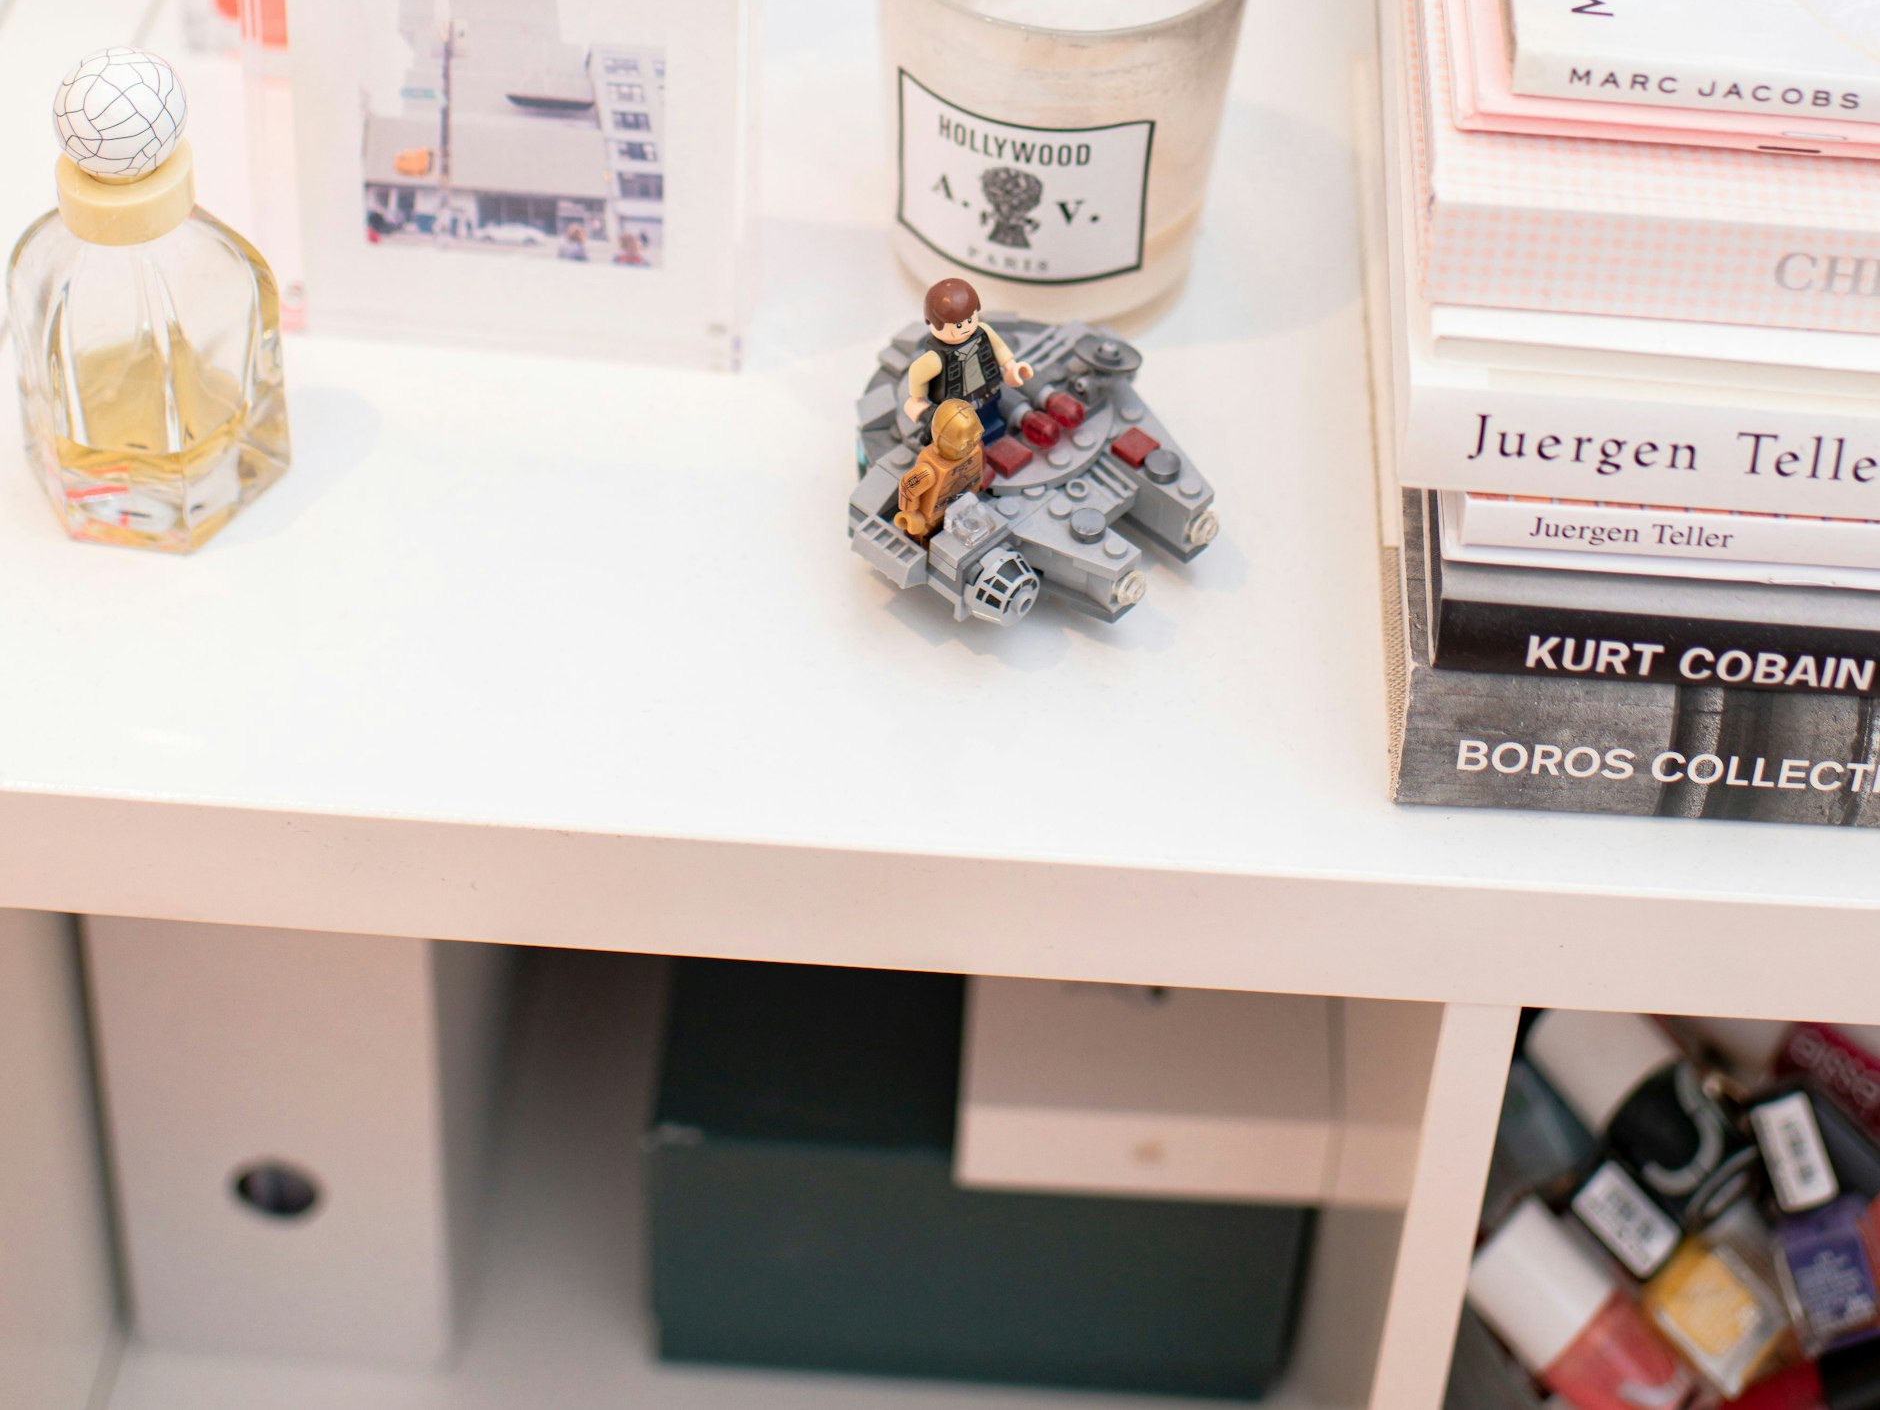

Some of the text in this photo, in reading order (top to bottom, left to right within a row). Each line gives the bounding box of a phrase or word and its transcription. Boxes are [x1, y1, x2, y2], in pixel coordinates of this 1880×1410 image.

[1568, 67, 1861, 111] MARC JACOBS
[937, 114, 1092, 167] HOLLYWOOD
[966, 245, 1048, 272] PARIS
[1467, 413, 1699, 477] Juergen
[1528, 516, 1735, 549] Juergen Teller
[1525, 635, 1876, 691] KURT COBAIN
[1456, 739, 1636, 781] BOROS
